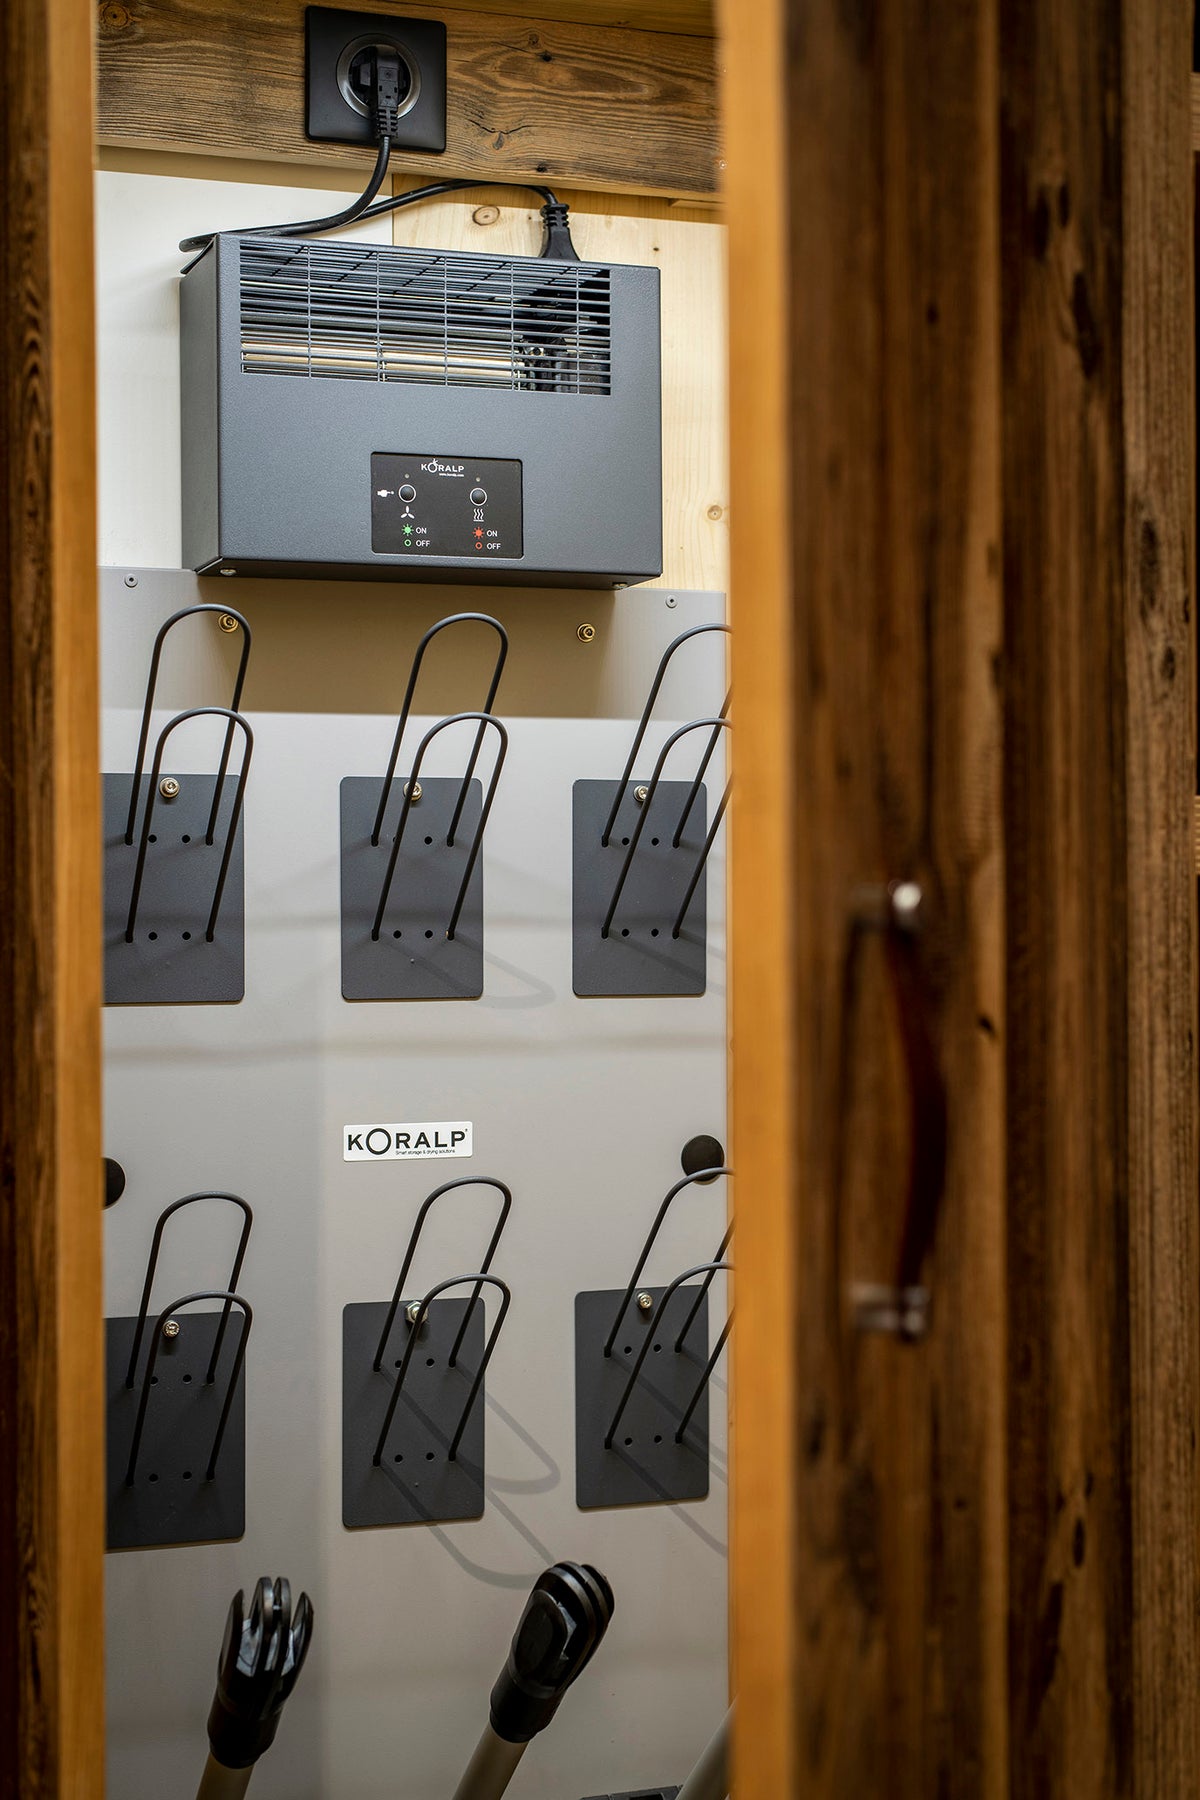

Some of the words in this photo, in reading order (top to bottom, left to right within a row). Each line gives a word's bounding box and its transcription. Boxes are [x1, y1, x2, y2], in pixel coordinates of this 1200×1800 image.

[421, 460, 464, 473] KORALP
[415, 526, 427, 534] ON
[415, 539, 430, 547] OFF
